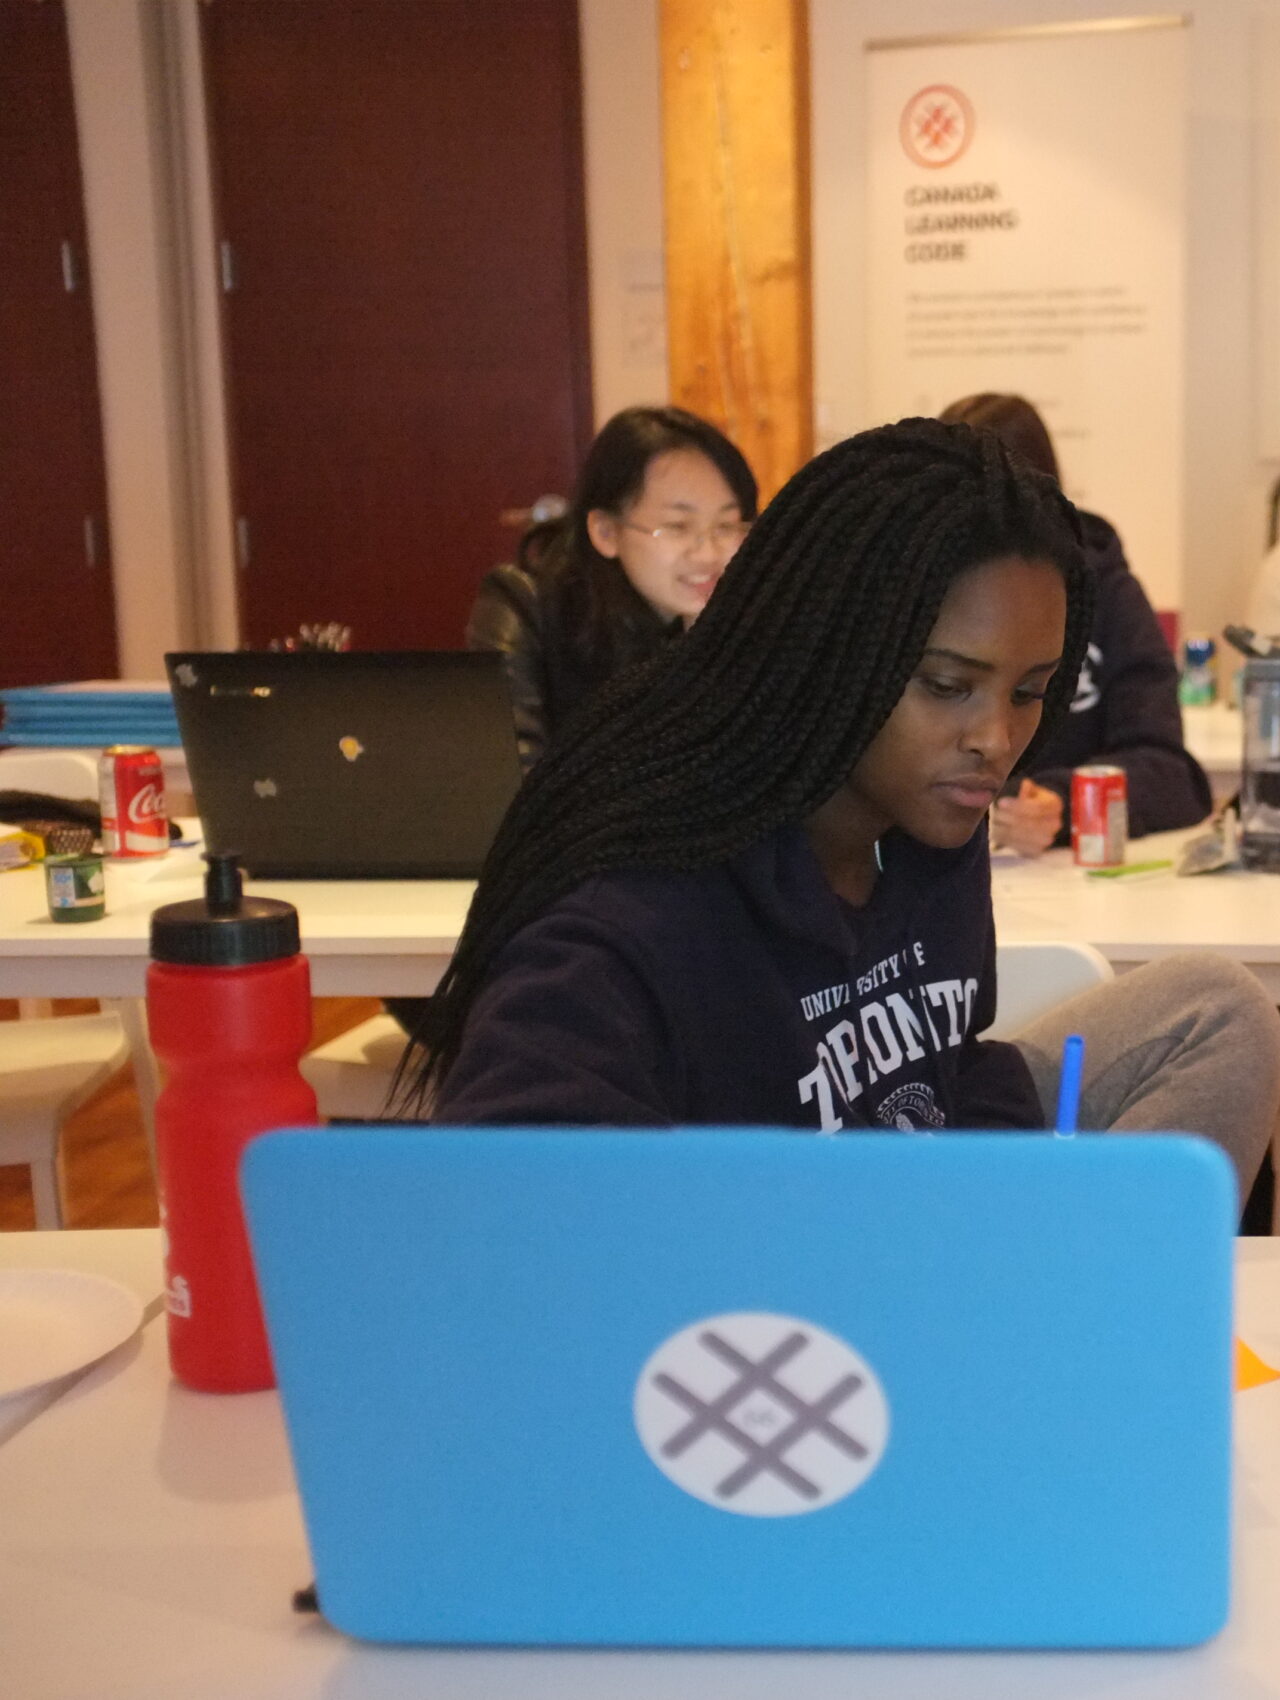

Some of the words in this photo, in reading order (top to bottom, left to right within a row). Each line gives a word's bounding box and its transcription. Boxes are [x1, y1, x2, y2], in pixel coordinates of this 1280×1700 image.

[904, 183, 1000, 206] CANADA
[904, 209, 1020, 234] LEARNING
[903, 241, 967, 263] CODE
